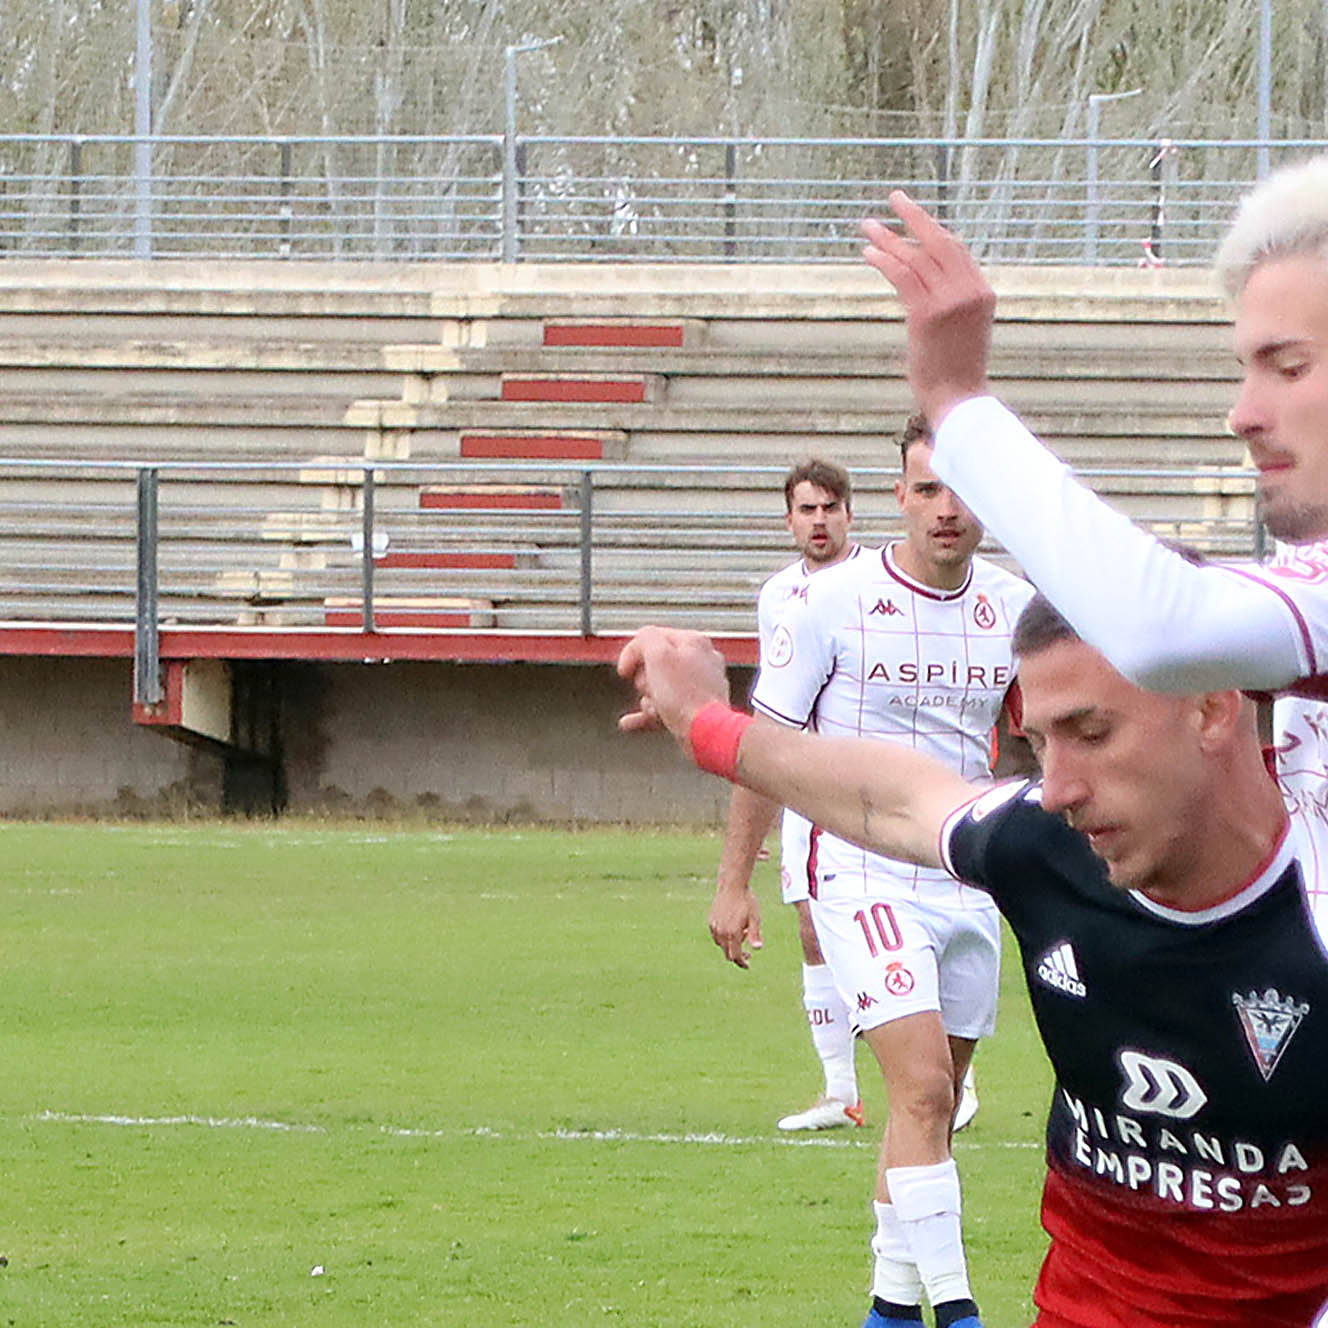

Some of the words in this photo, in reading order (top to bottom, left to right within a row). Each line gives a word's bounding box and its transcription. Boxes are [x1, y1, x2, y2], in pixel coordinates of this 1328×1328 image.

[868, 660, 1009, 689] ASPIRE
[888, 695, 989, 708] ACADEMY
[854, 903, 904, 958] 10
[1038, 965, 1087, 997] adidas
[1063, 1088, 1309, 1174] MIRANDA
